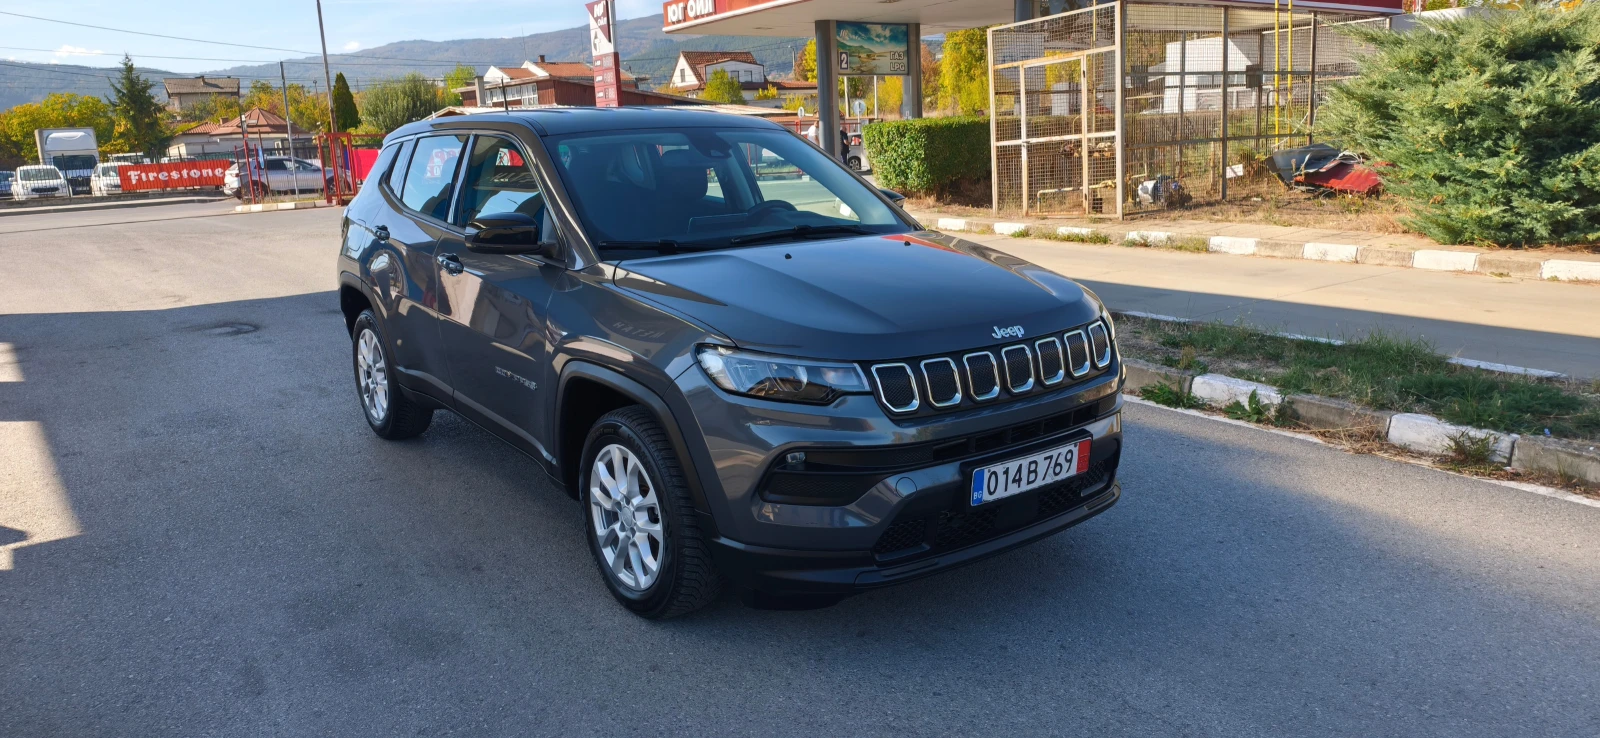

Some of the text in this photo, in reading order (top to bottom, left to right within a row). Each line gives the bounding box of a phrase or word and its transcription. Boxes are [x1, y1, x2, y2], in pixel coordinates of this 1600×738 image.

[667, 2, 685, 23] ЮГ
[841, 53, 847, 68] 2
[890, 50, 904, 60] ГАЗ
[890, 62, 905, 71] LPG
[127, 167, 224, 185] Firestone
[992, 325, 1025, 339] Jeep
[973, 491, 983, 500] BG
